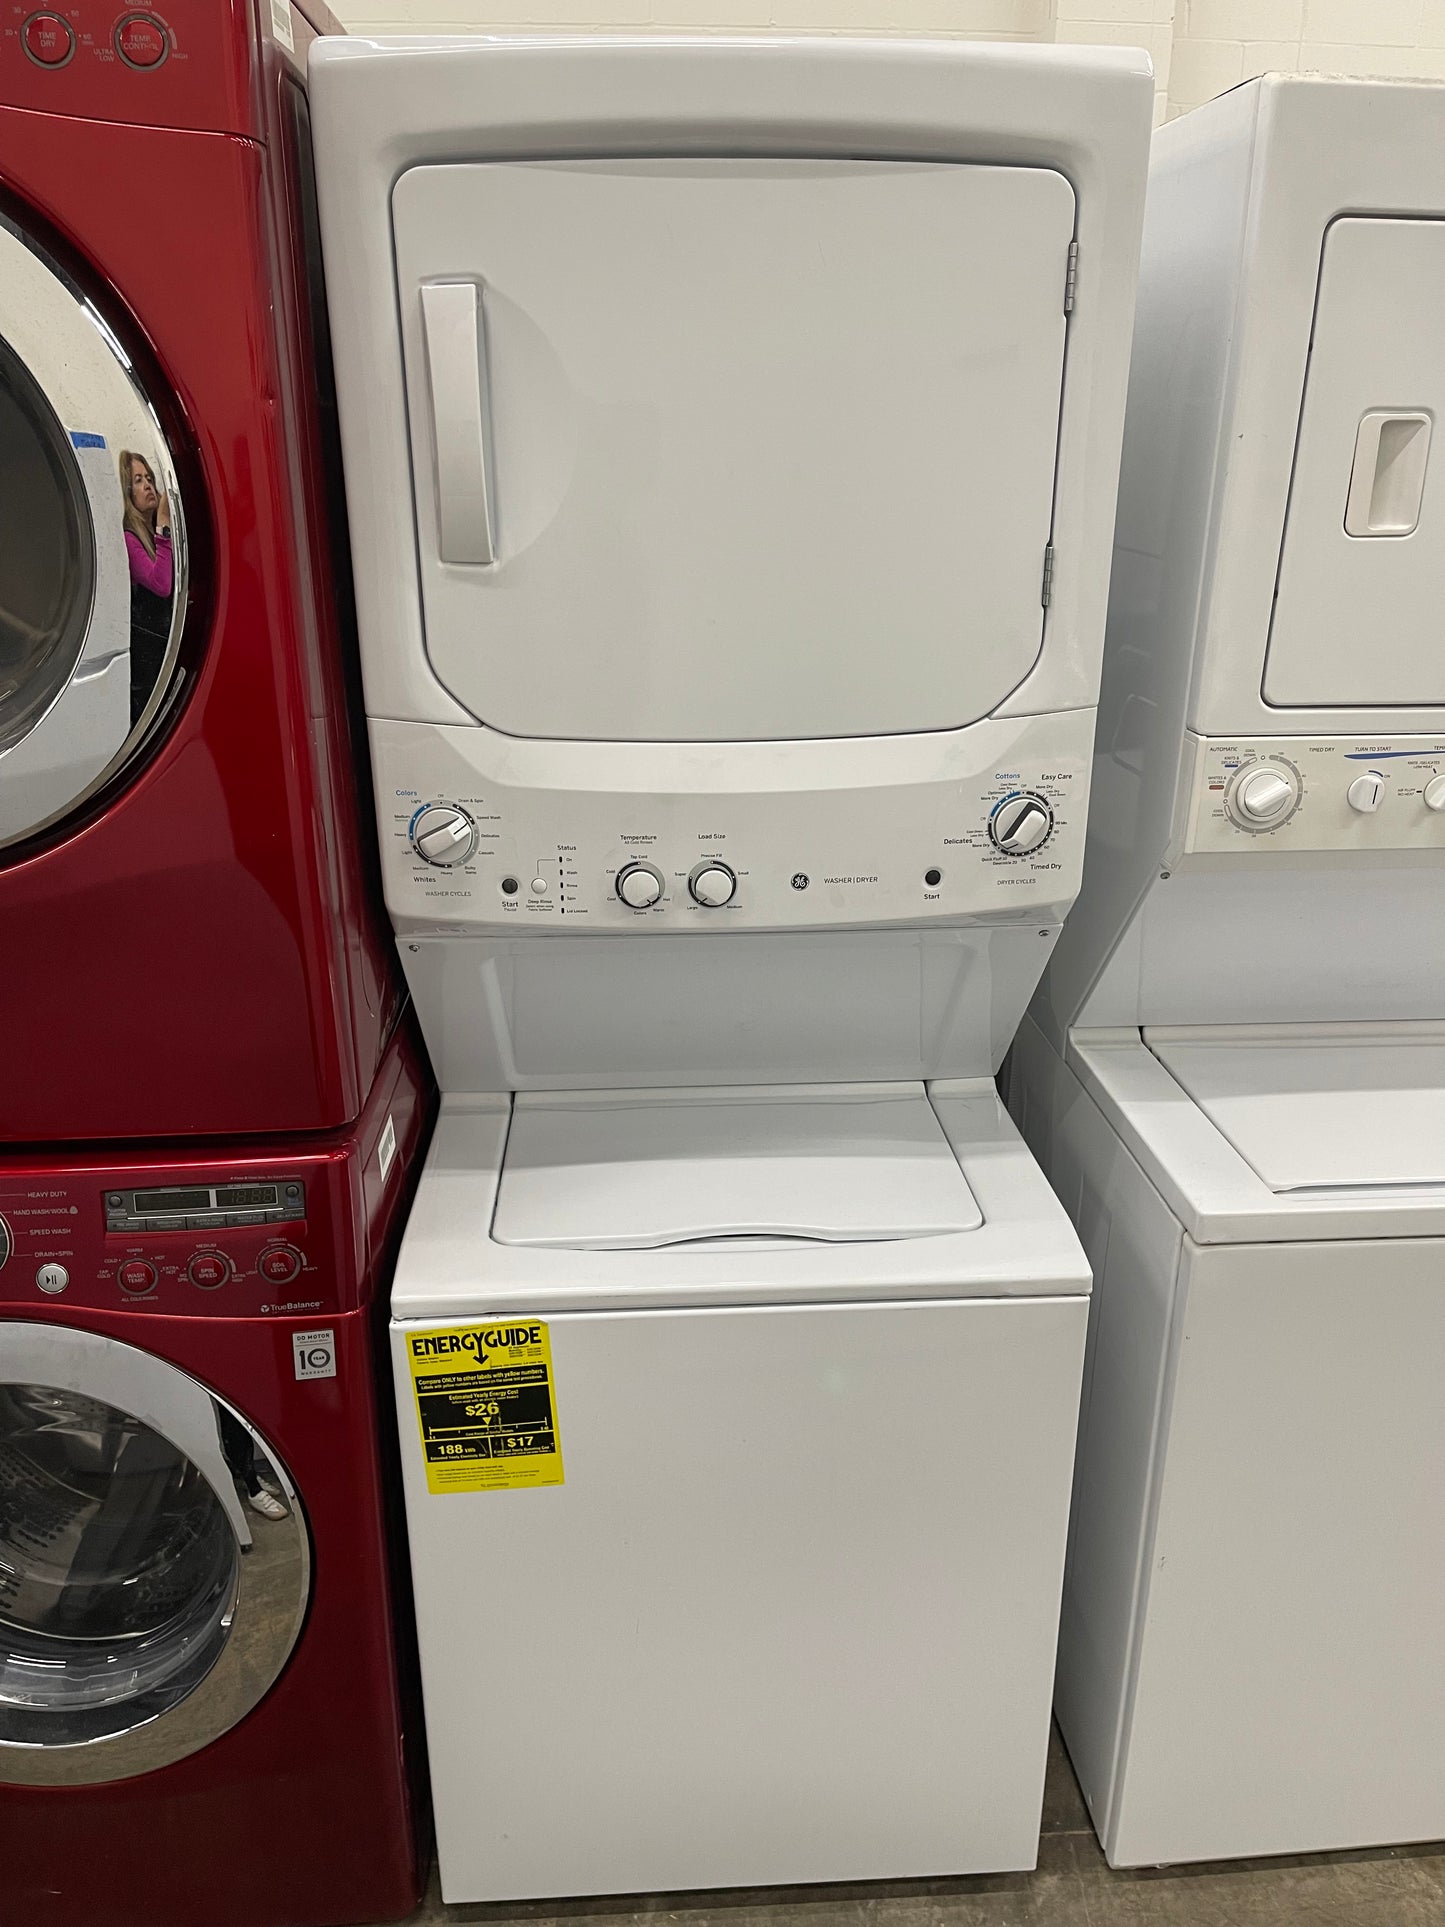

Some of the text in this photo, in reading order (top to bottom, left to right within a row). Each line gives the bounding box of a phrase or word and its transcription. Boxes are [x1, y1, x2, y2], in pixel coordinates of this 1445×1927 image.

[38, 31, 56, 39] TIME
[123, 42, 159, 50] CONTROL
[620, 834, 657, 842] Temperature
[412, 1327, 541, 1358] ENERGYGUIDE
[299, 1348, 330, 1369] 10
[465, 1402, 499, 1416] $26
[507, 1436, 534, 1448] $17
[438, 1444, 463, 1455] 188
